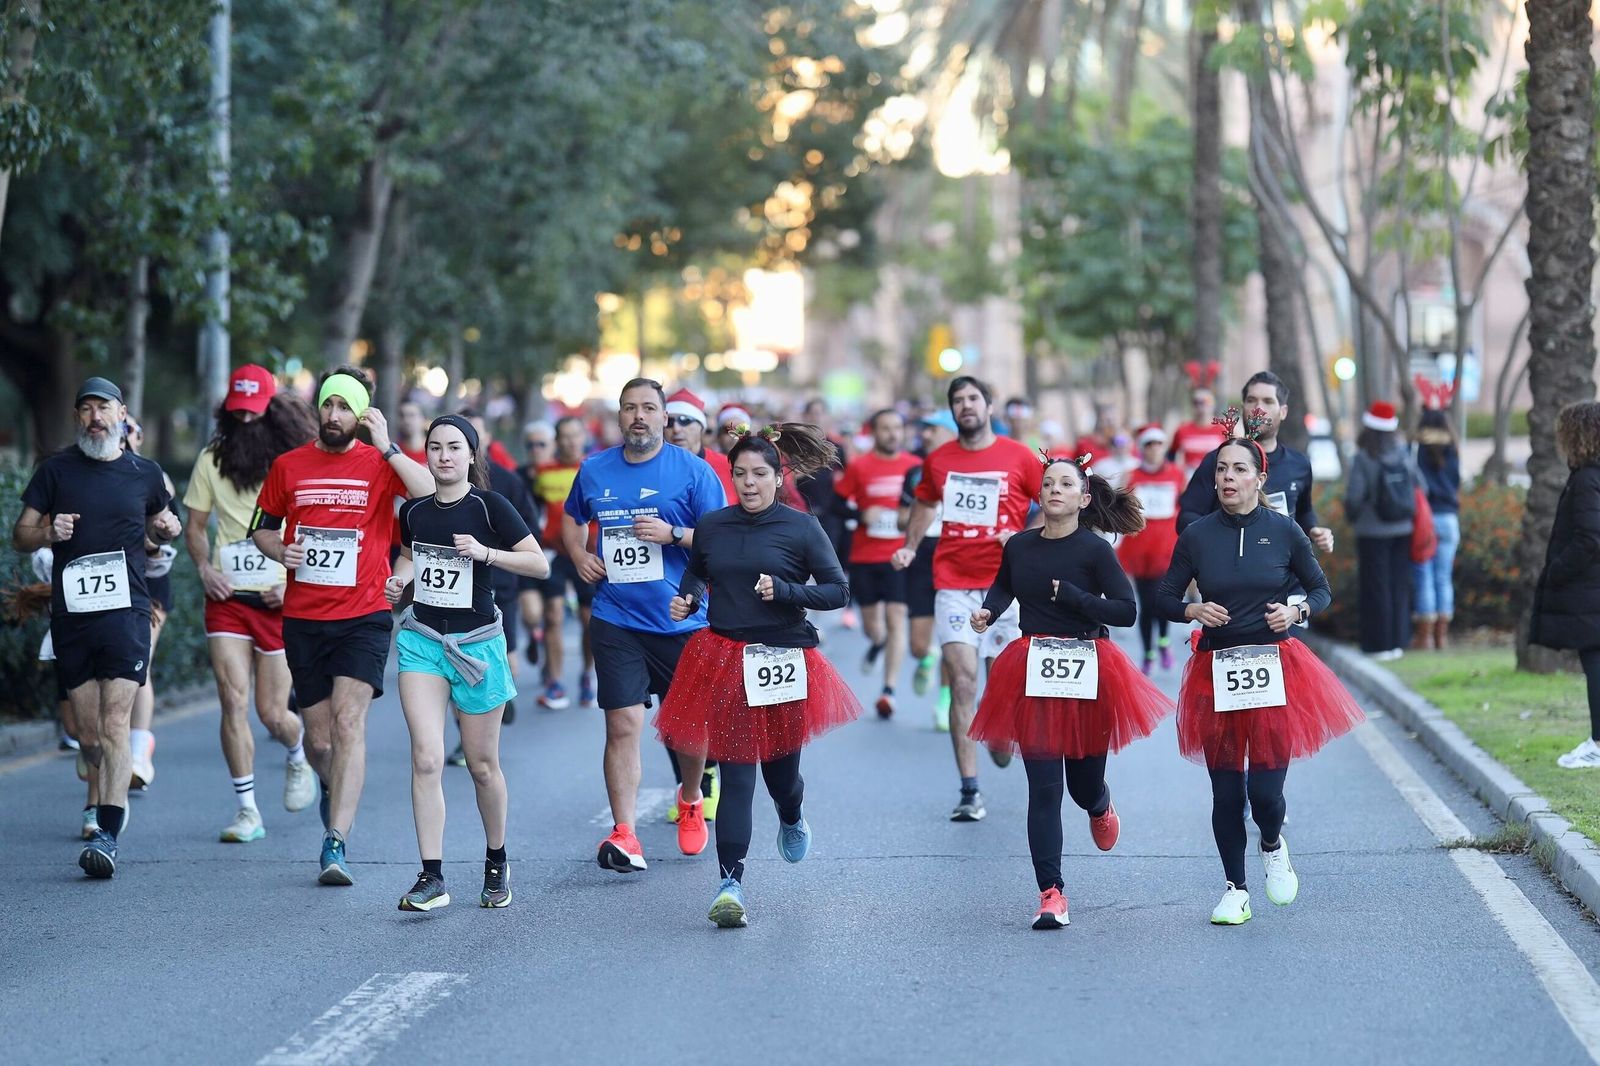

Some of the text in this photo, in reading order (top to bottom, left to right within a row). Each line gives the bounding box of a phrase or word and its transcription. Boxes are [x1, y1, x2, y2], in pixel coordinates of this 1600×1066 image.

[955, 492, 987, 510] 263
[232, 555, 266, 571] 162
[306, 549, 345, 568] 827
[613, 546, 650, 566] 493
[77, 574, 116, 595] 175
[421, 568, 460, 589] 437
[758, 663, 795, 687] 932
[1041, 658, 1085, 679] 857
[1227, 668, 1270, 691] 539
